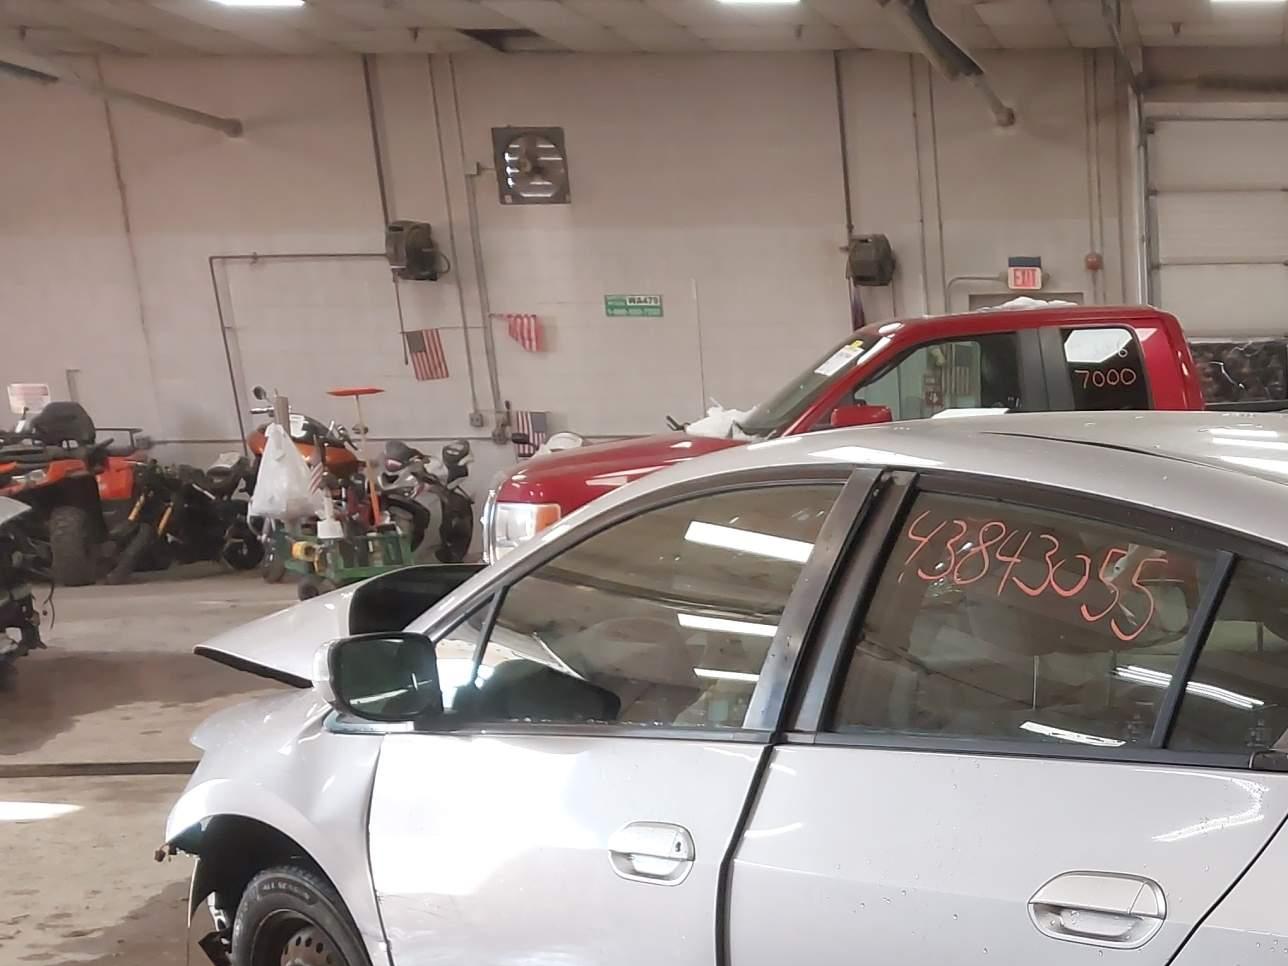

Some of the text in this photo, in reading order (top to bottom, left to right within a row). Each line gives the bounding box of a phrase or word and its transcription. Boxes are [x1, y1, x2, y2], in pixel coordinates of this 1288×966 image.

[1013, 268, 1036, 288] EXIT
[1074, 368, 1137, 389] 7000
[898, 509, 1183, 641] 43843055
